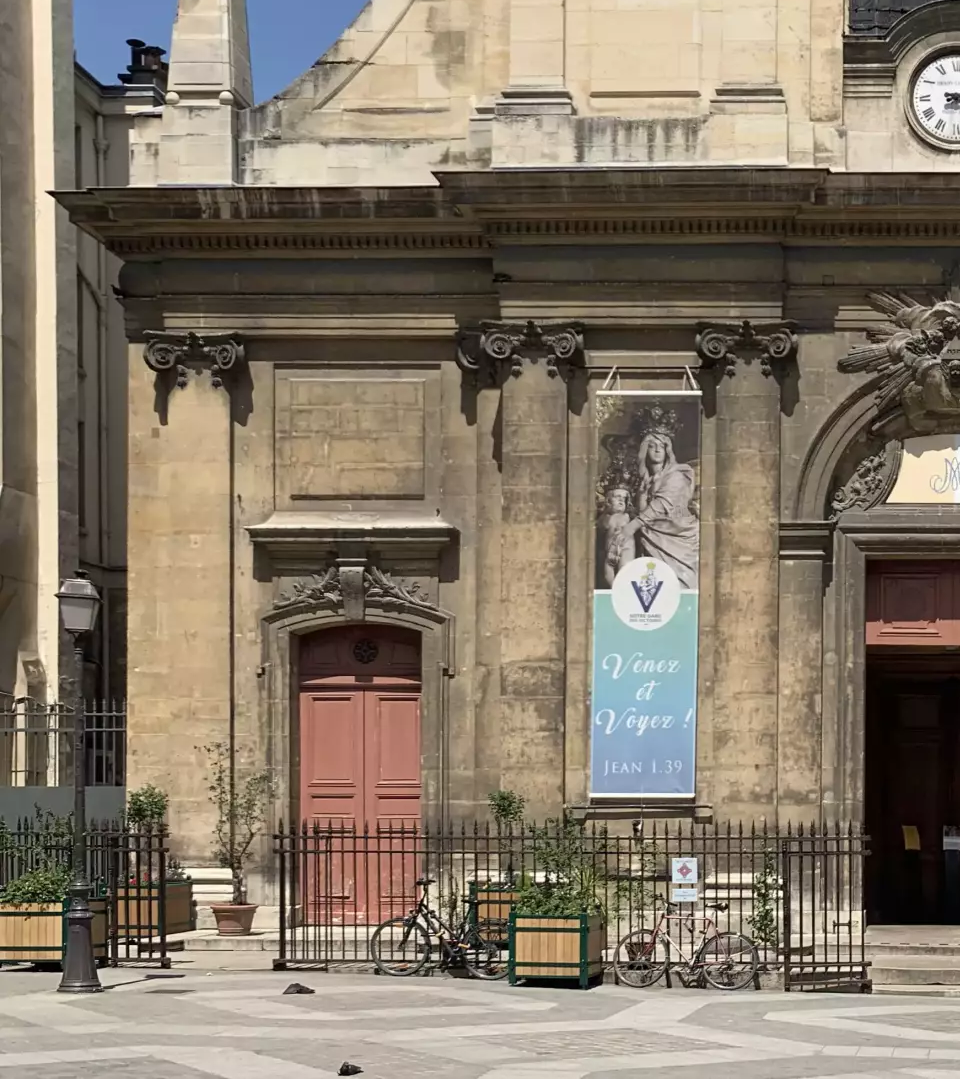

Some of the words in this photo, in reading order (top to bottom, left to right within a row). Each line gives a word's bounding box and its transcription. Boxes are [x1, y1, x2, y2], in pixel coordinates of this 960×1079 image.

[602, 652, 681, 680] Venez
[635, 680, 661, 701] et
[595, 707, 675, 736] Voyez
[604, 759, 643, 776] JEAN
[651, 759, 683, 774] 1.39
